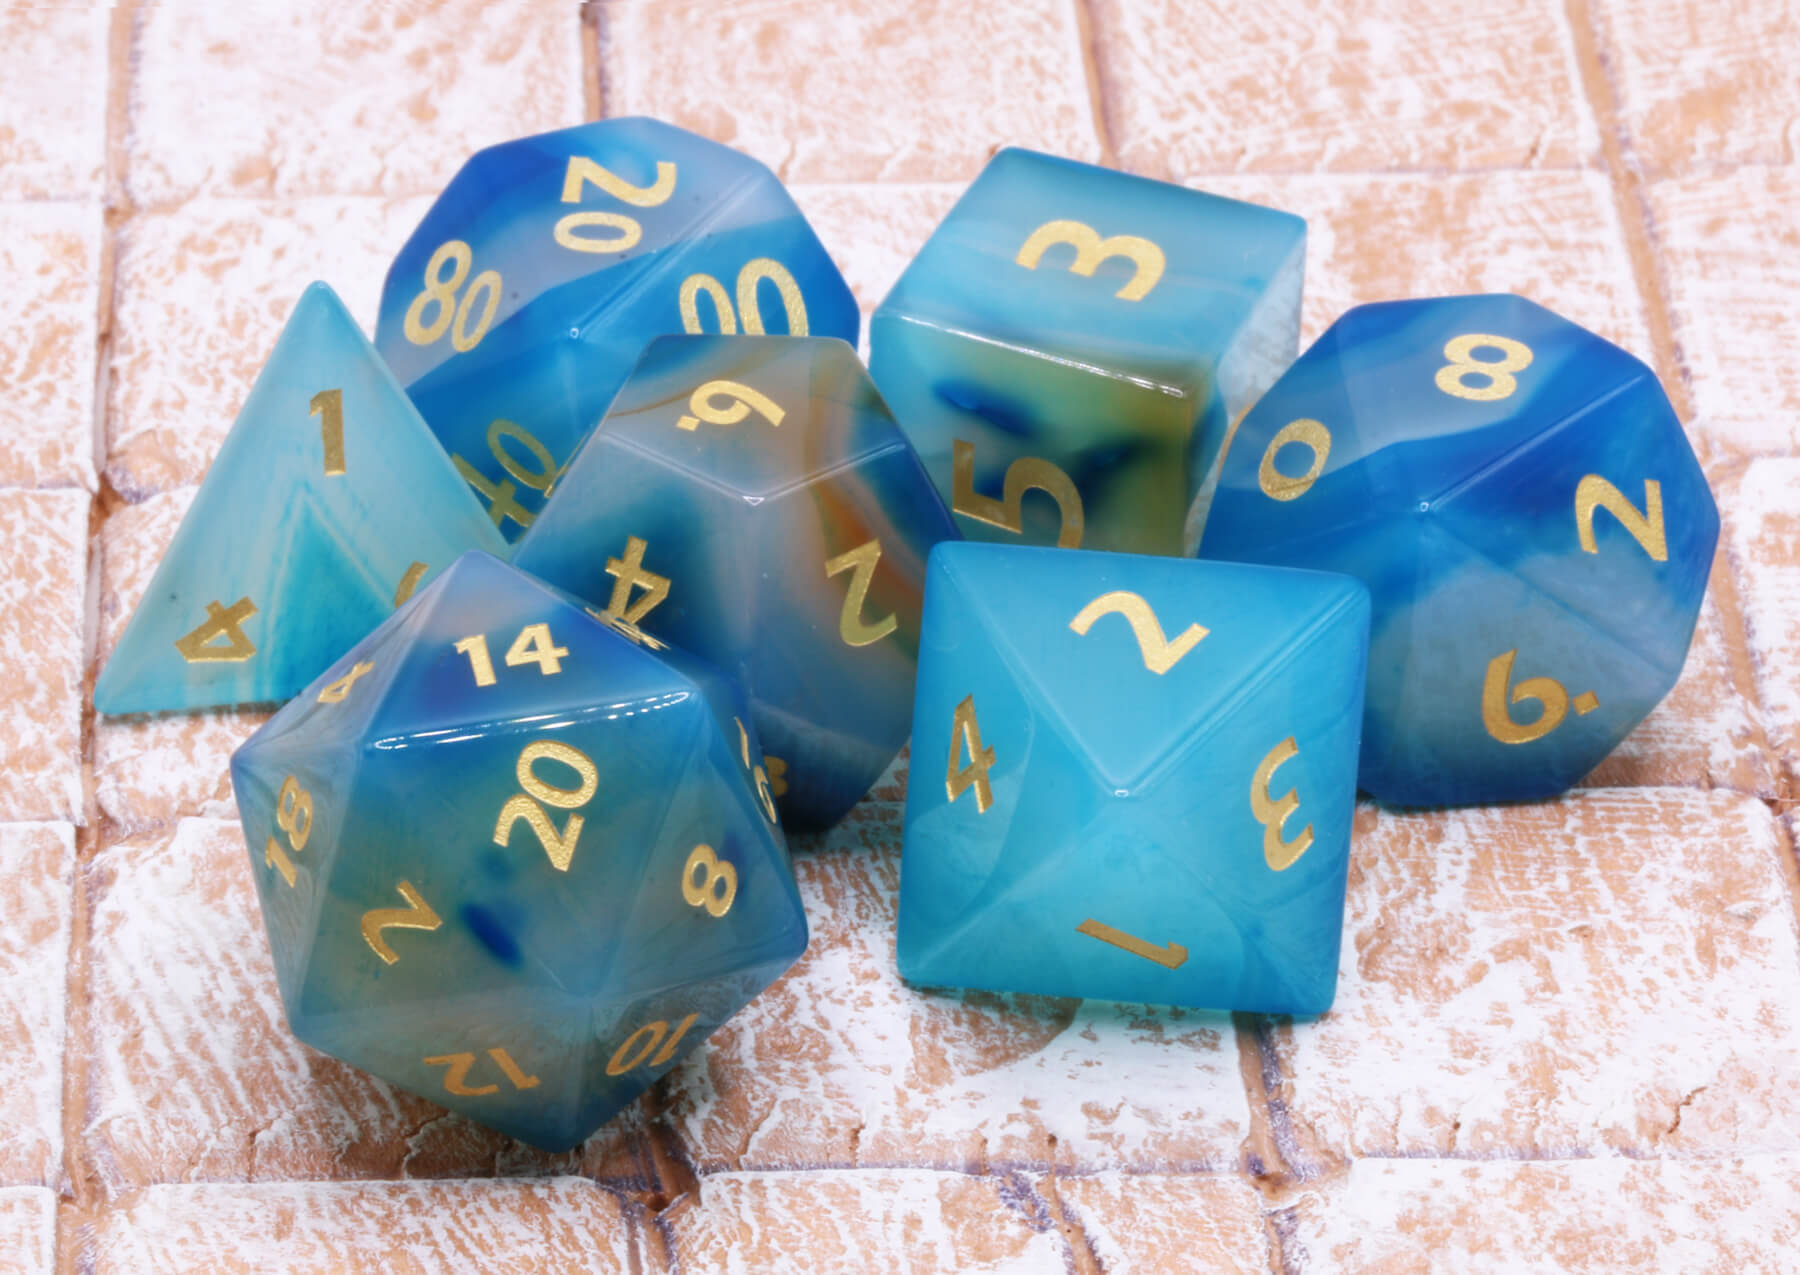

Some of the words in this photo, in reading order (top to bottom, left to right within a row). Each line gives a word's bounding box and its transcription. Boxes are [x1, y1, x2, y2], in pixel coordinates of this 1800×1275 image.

[553, 156, 677, 253] 20
[403, 240, 502, 352] 80
[680, 258, 809, 336] 00
[1016, 220, 1166, 301] 3
[1435, 334, 1534, 401] 8
[309, 388, 346, 476] 1
[953, 438, 1084, 549] 5
[1575, 474, 1668, 562] 2
[605, 535, 671, 624] 4
[825, 538, 898, 647] 2
[174, 596, 258, 662] 4
[454, 623, 570, 687] 14
[1069, 591, 1210, 675] 2
[317, 661, 374, 703] 4
[945, 694, 996, 814] 4
[265, 775, 313, 888] 18
[493, 739, 599, 872] 20
[1250, 736, 1314, 871] 3
[361, 880, 443, 965] 2
[682, 844, 738, 918] 8
[1075, 918, 1188, 969] 1
[423, 1048, 541, 1096] 12
[605, 1013, 700, 1077] 10
